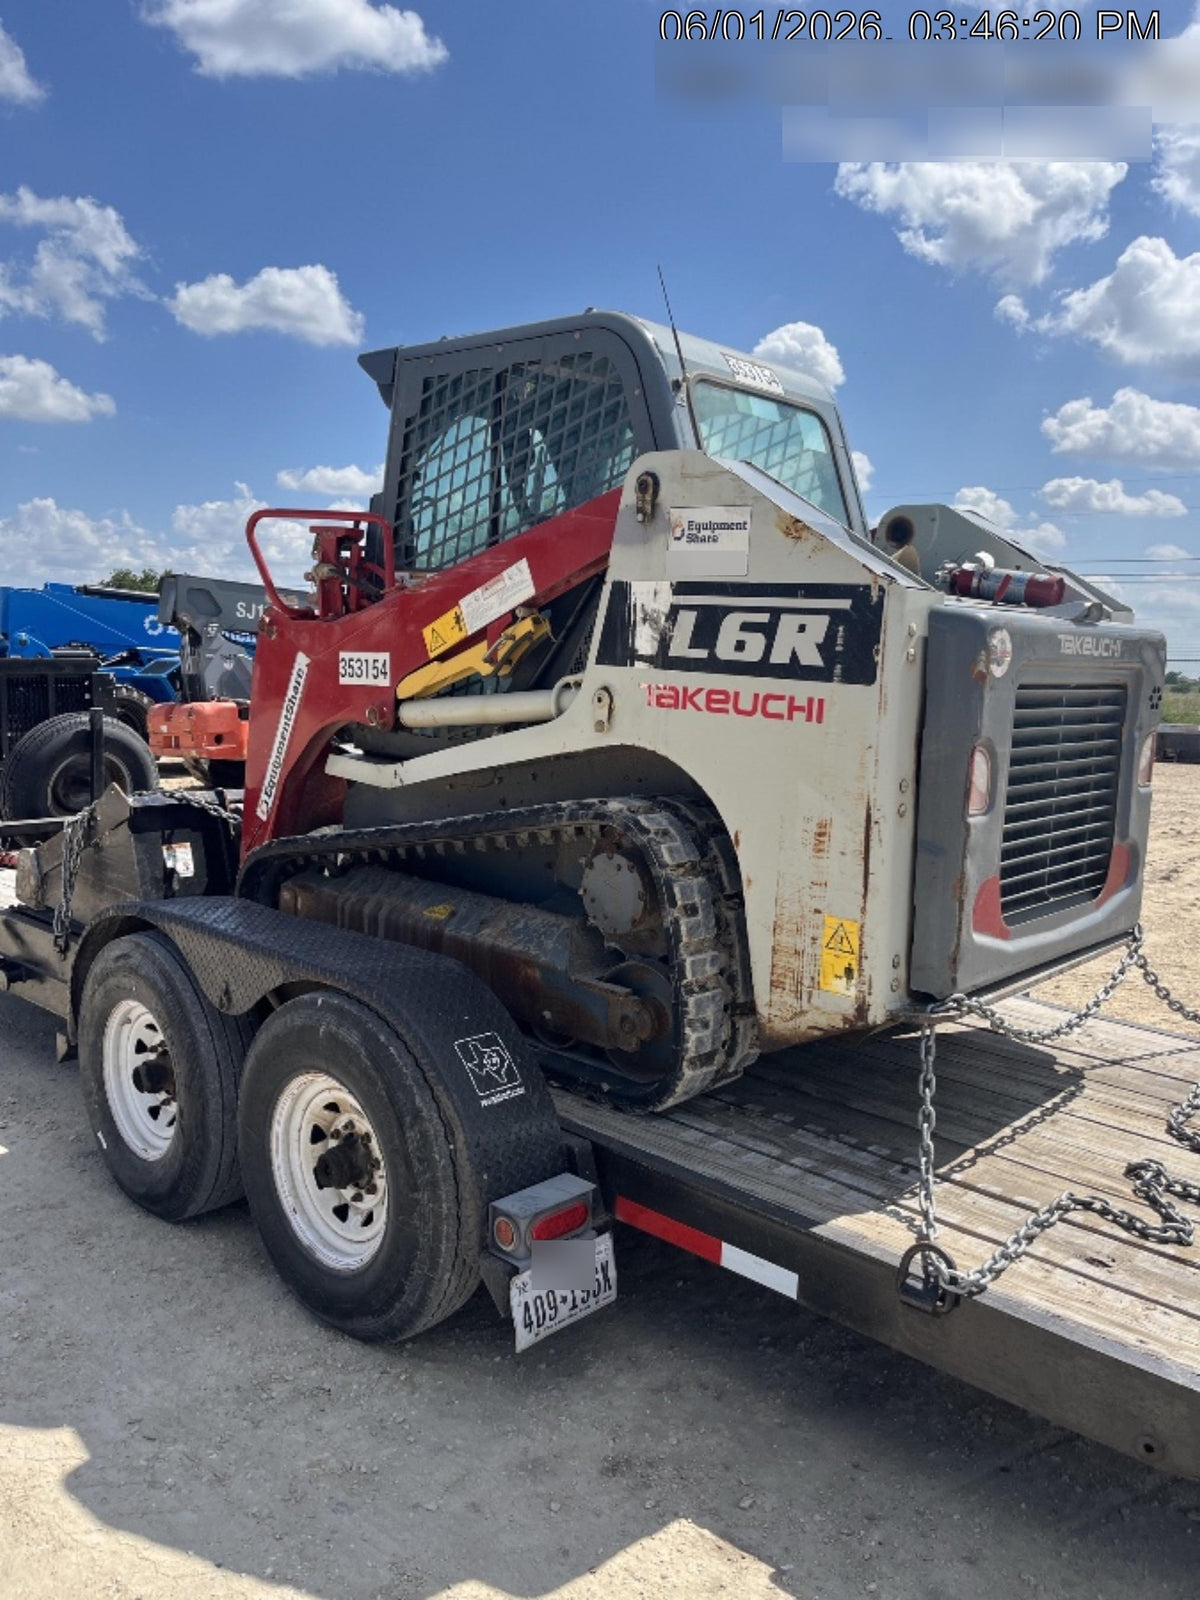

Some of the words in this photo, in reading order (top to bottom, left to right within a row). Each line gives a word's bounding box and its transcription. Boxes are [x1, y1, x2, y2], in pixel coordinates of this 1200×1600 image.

[686, 520, 748, 534] Equipment
[685, 533, 720, 543] Share
[236, 602, 264, 619] SJ1
[339, 656, 389, 680] 353154
